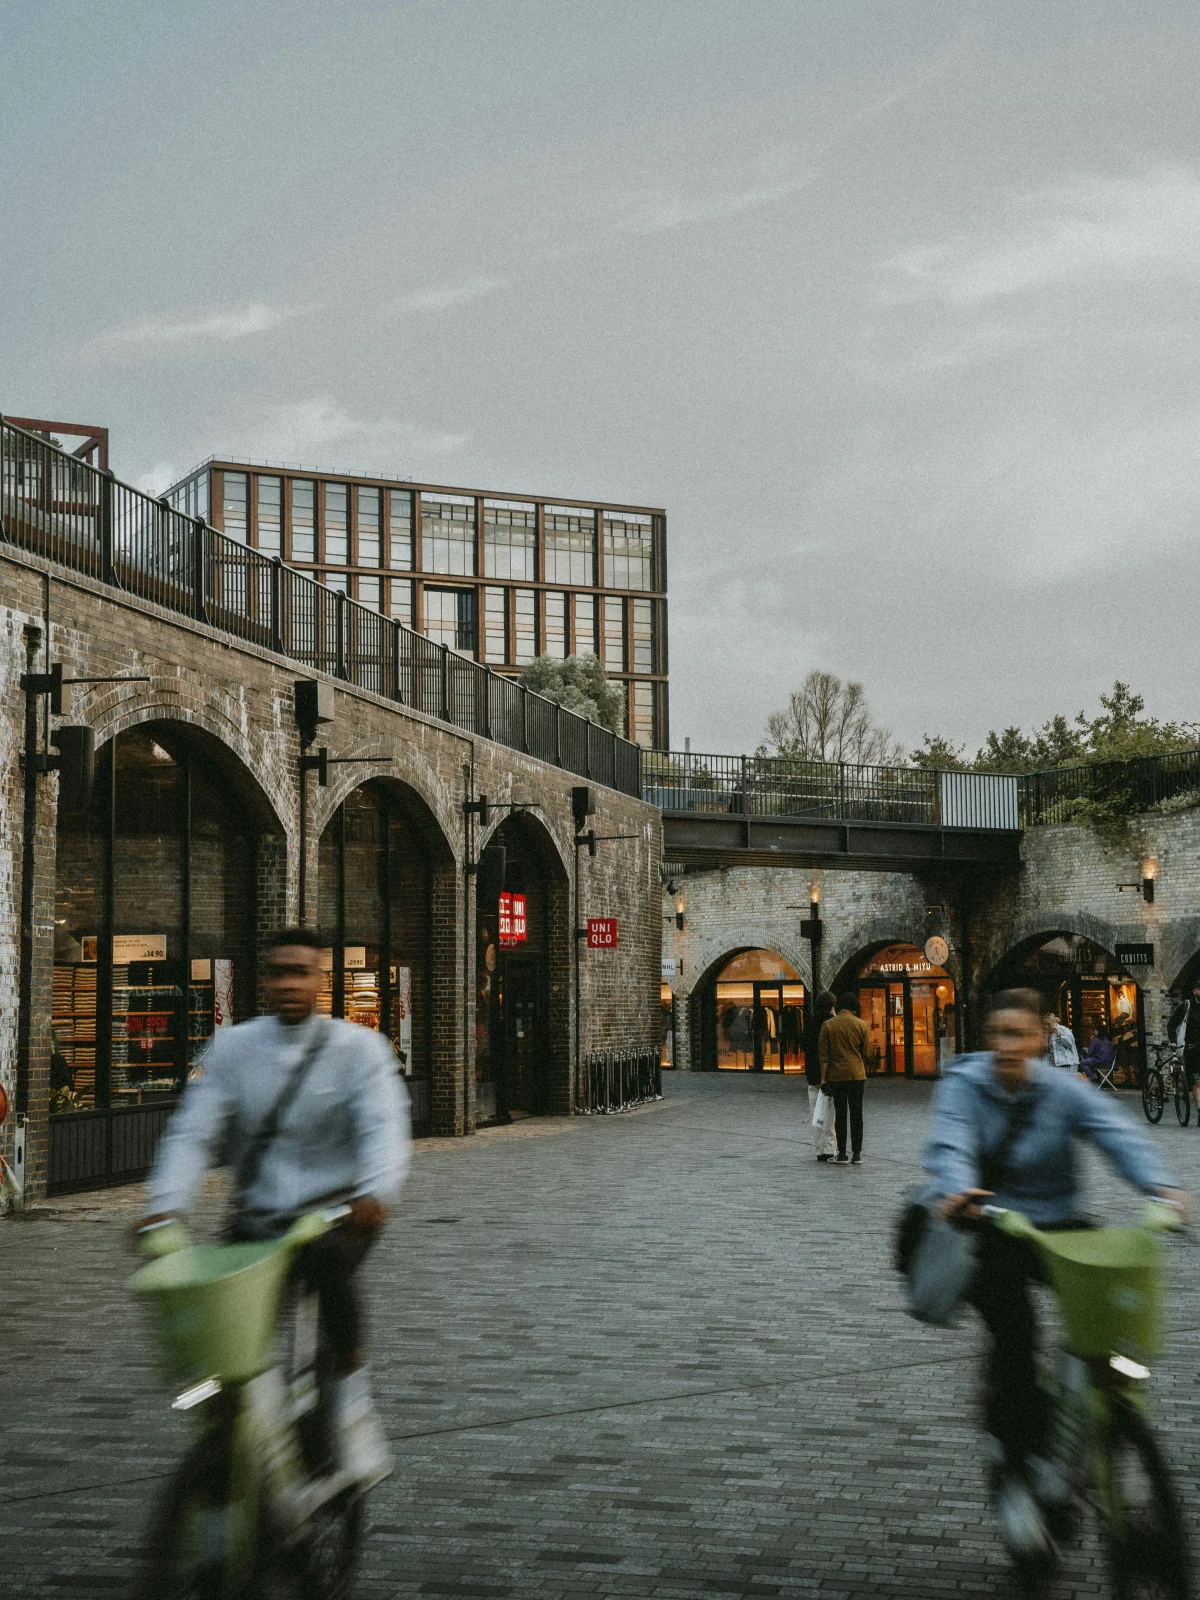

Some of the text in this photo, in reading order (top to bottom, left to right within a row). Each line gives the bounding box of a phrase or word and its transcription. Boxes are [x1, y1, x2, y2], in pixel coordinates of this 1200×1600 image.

[513, 901, 524, 915] UNI
[514, 919, 525, 936] QLO
[591, 923, 610, 933] UNI
[591, 934, 612, 945] QLO
[1120, 953, 1148, 964] CUBITTS
[880, 962, 931, 972] ASTRID & MIYU
